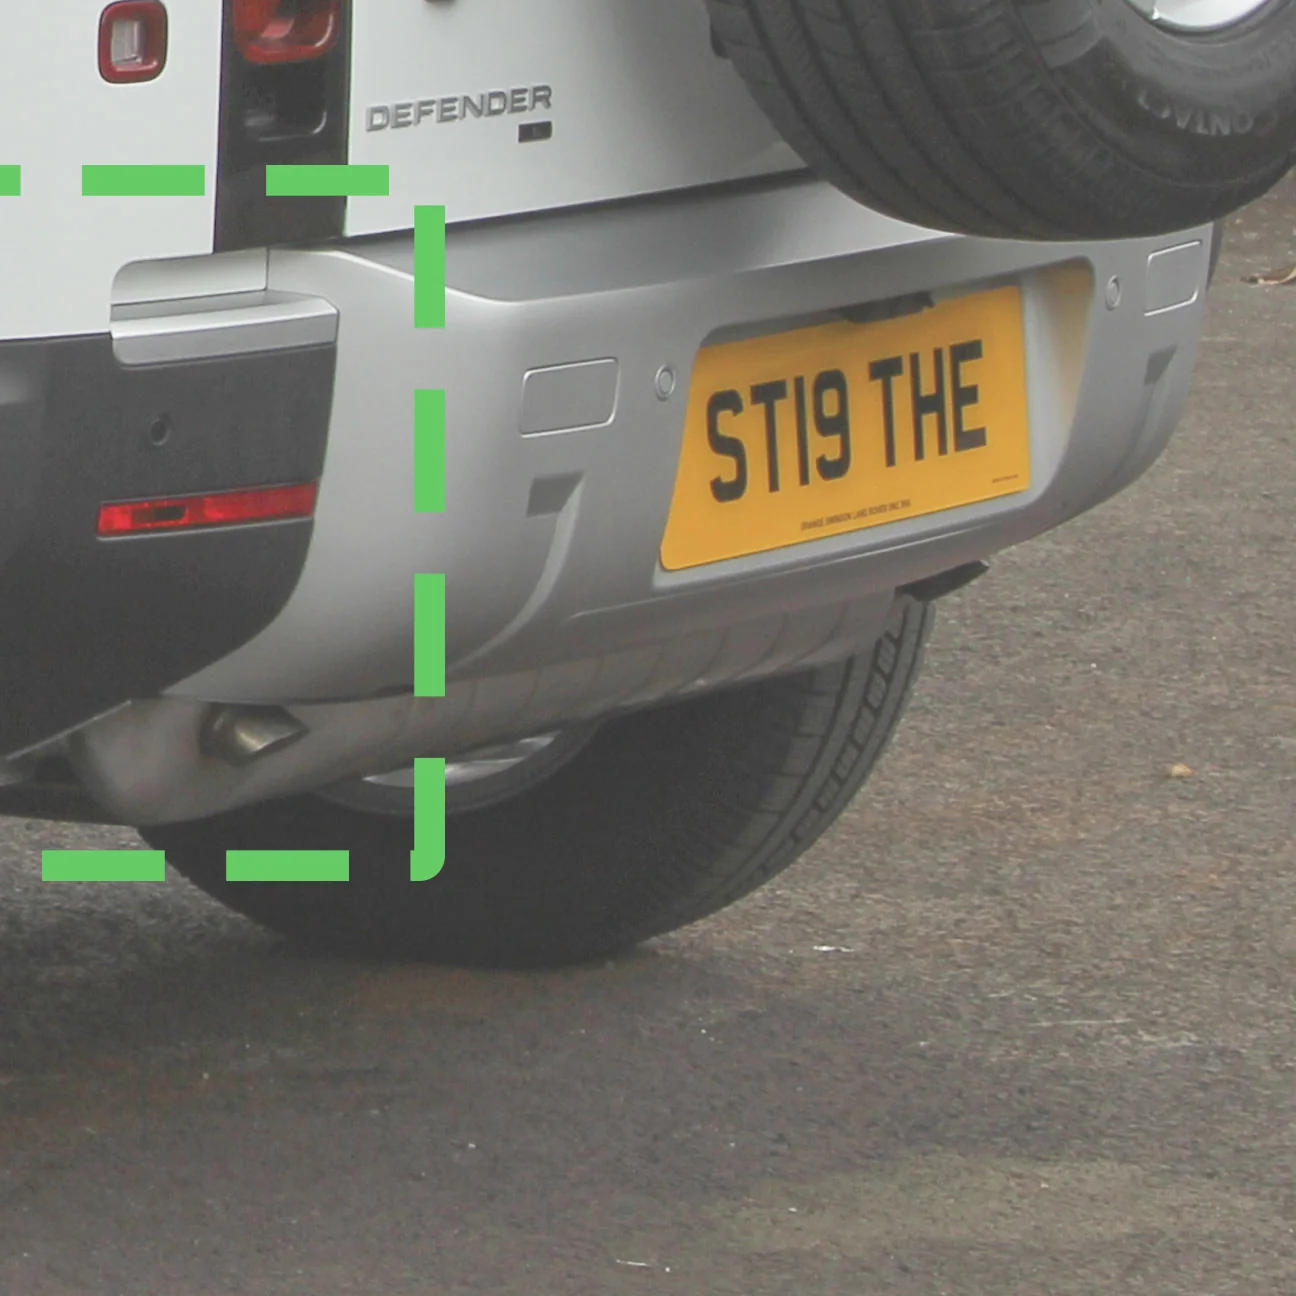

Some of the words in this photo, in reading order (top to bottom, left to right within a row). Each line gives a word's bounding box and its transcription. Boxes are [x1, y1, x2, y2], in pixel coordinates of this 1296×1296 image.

[366, 84, 553, 132] DEFENDER
[707, 368, 851, 503] ST19
[868, 339, 987, 467] THE
